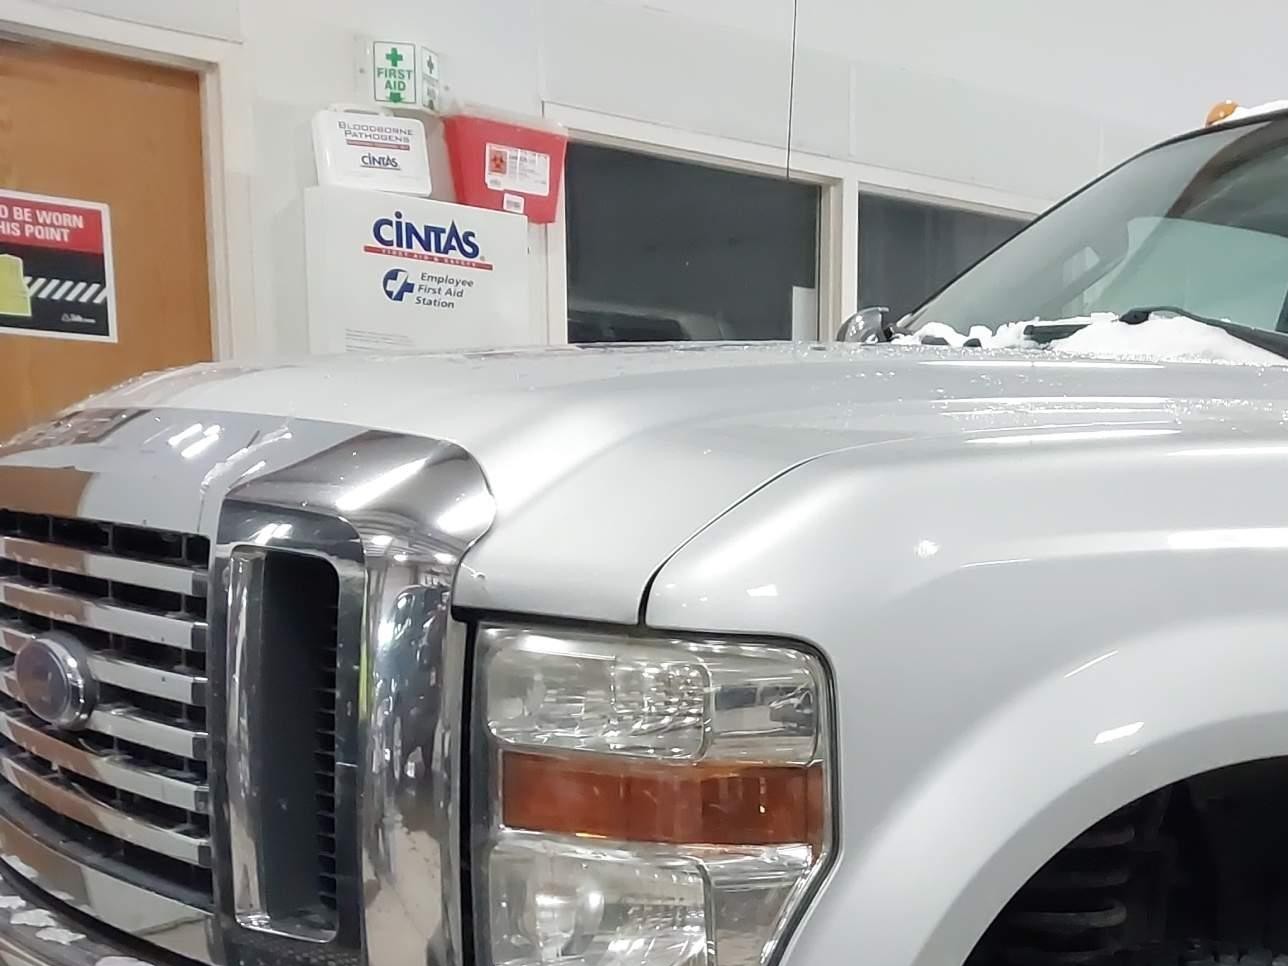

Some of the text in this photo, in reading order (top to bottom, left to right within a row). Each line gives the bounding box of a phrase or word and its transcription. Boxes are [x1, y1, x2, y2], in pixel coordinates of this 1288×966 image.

[376, 67, 413, 80] FIRST
[384, 79, 406, 92] AID
[338, 120, 414, 136] BLOODBORNE
[344, 129, 410, 143] PATHOGENS
[13, 206, 33, 222] BE
[36, 209, 85, 229] WORN
[24, 224, 71, 242] POINT
[420, 272, 474, 288] Employee
[417, 284, 464, 298] First Aid
[415, 296, 455, 309] Station
